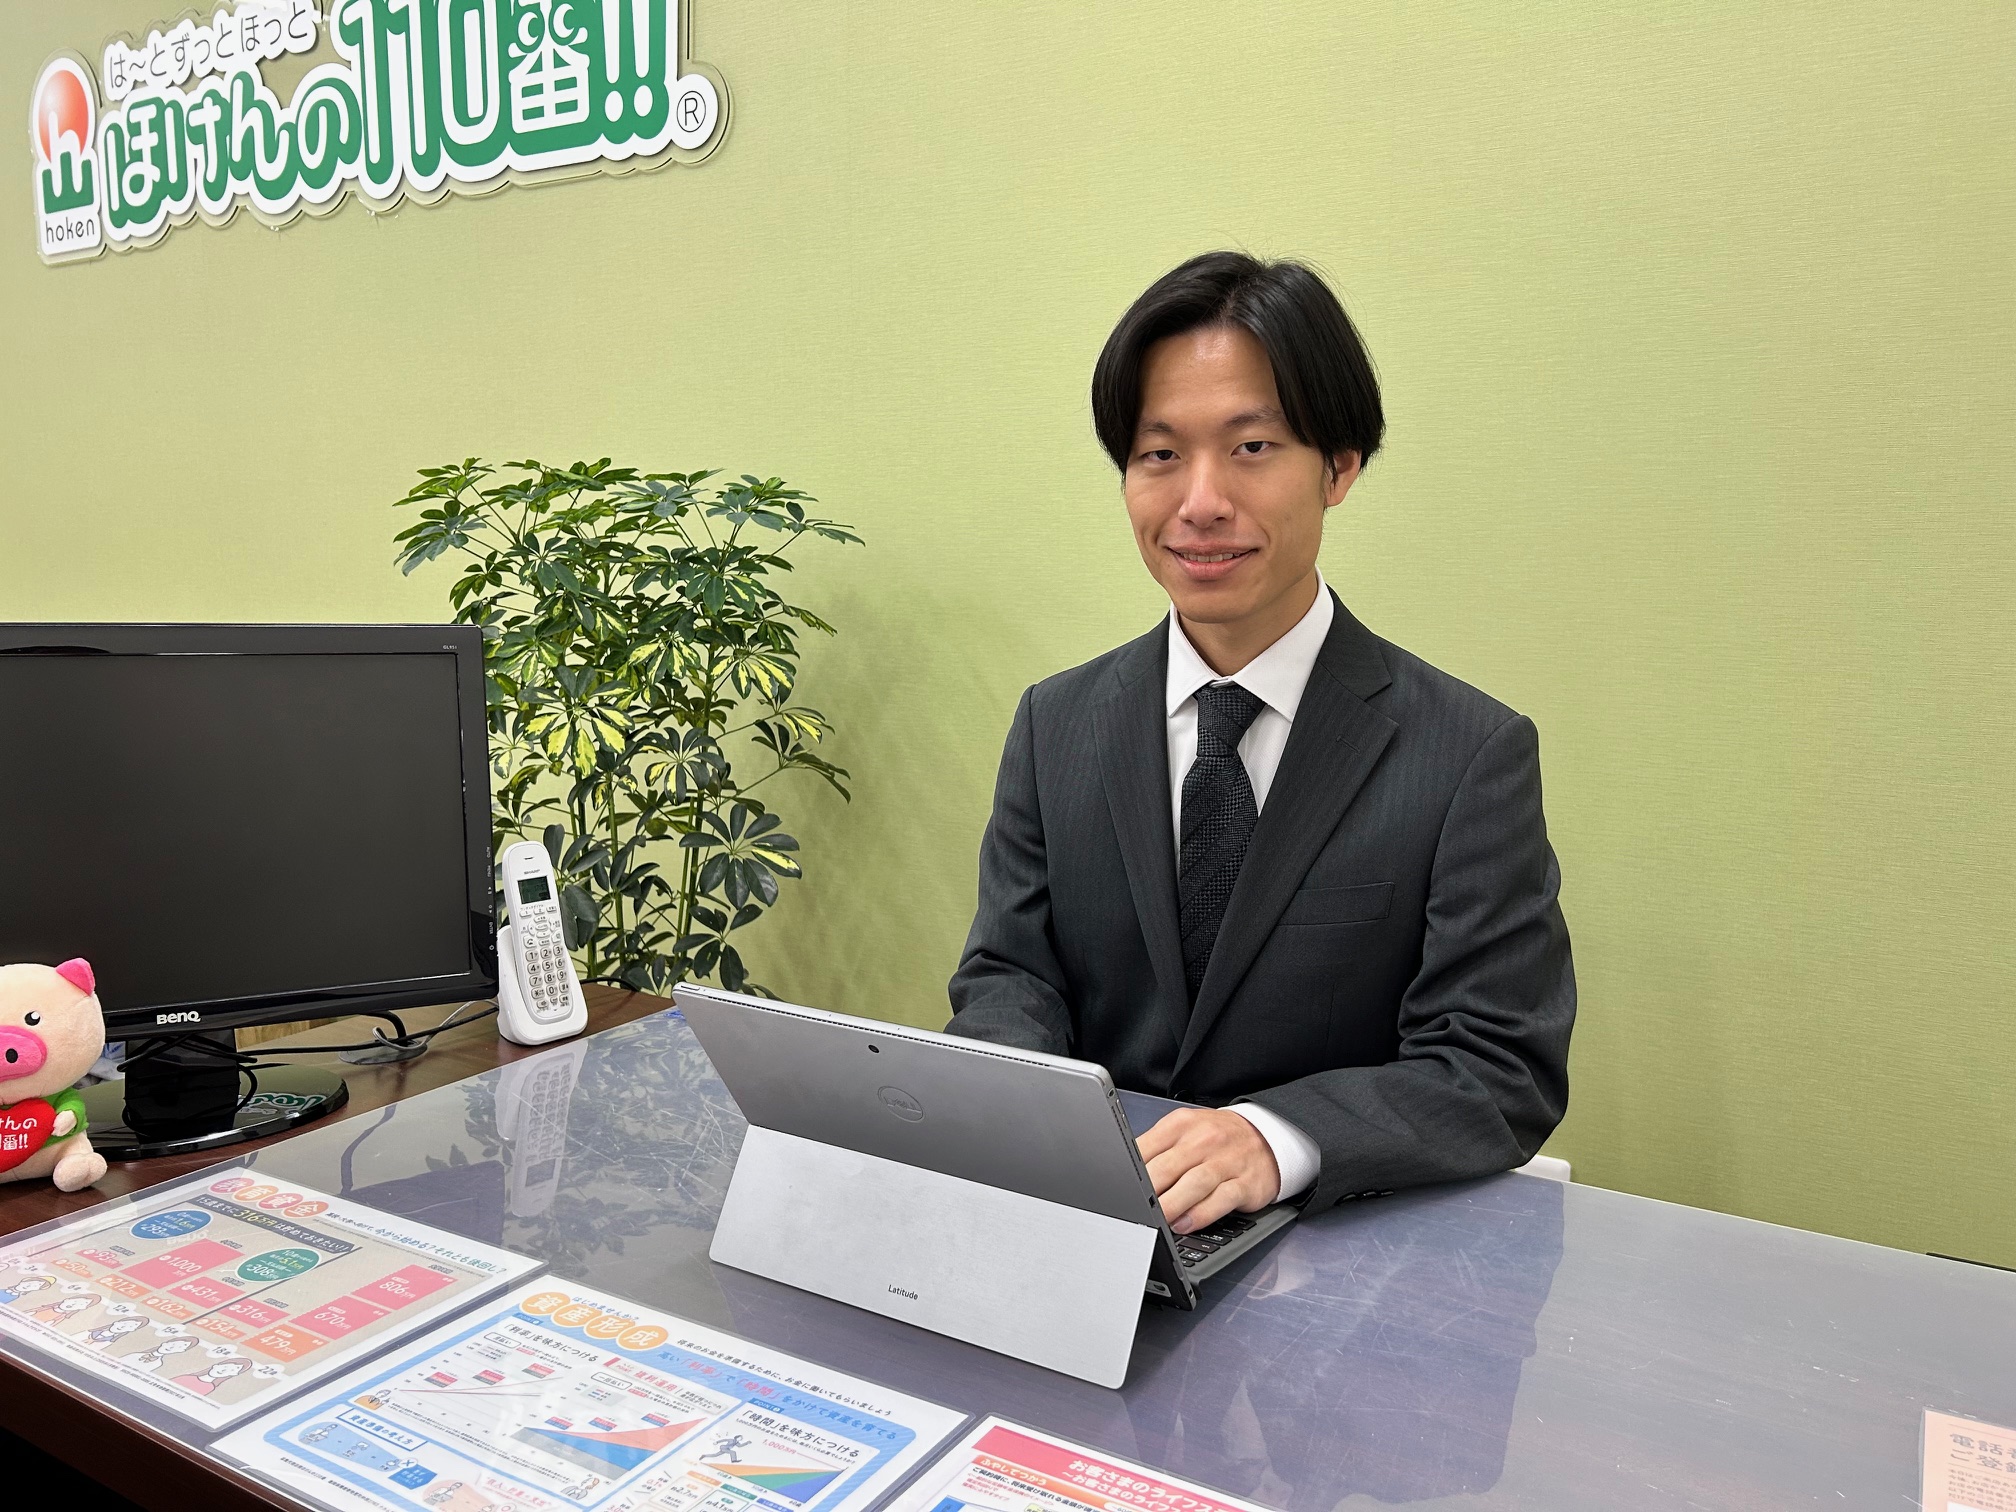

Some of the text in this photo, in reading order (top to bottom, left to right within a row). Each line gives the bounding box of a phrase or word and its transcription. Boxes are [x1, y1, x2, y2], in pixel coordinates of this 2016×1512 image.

[45, 218, 97, 245] hoken
[157, 1010, 201, 1025] BenQ
[0, 1133, 29, 1150] 番!!
[214, 1178, 319, 1217] 教育資金
[888, 1284, 919, 1301] Latitude
[527, 1293, 660, 1347] 資産形成
[572, 1296, 640, 1322] はじめませんか?
[742, 1410, 859, 1458] 「時間」を味方につける
[980, 1458, 1048, 1486] ふやしてつかう
[1068, 1460, 1229, 1512] お客さまのライフス
